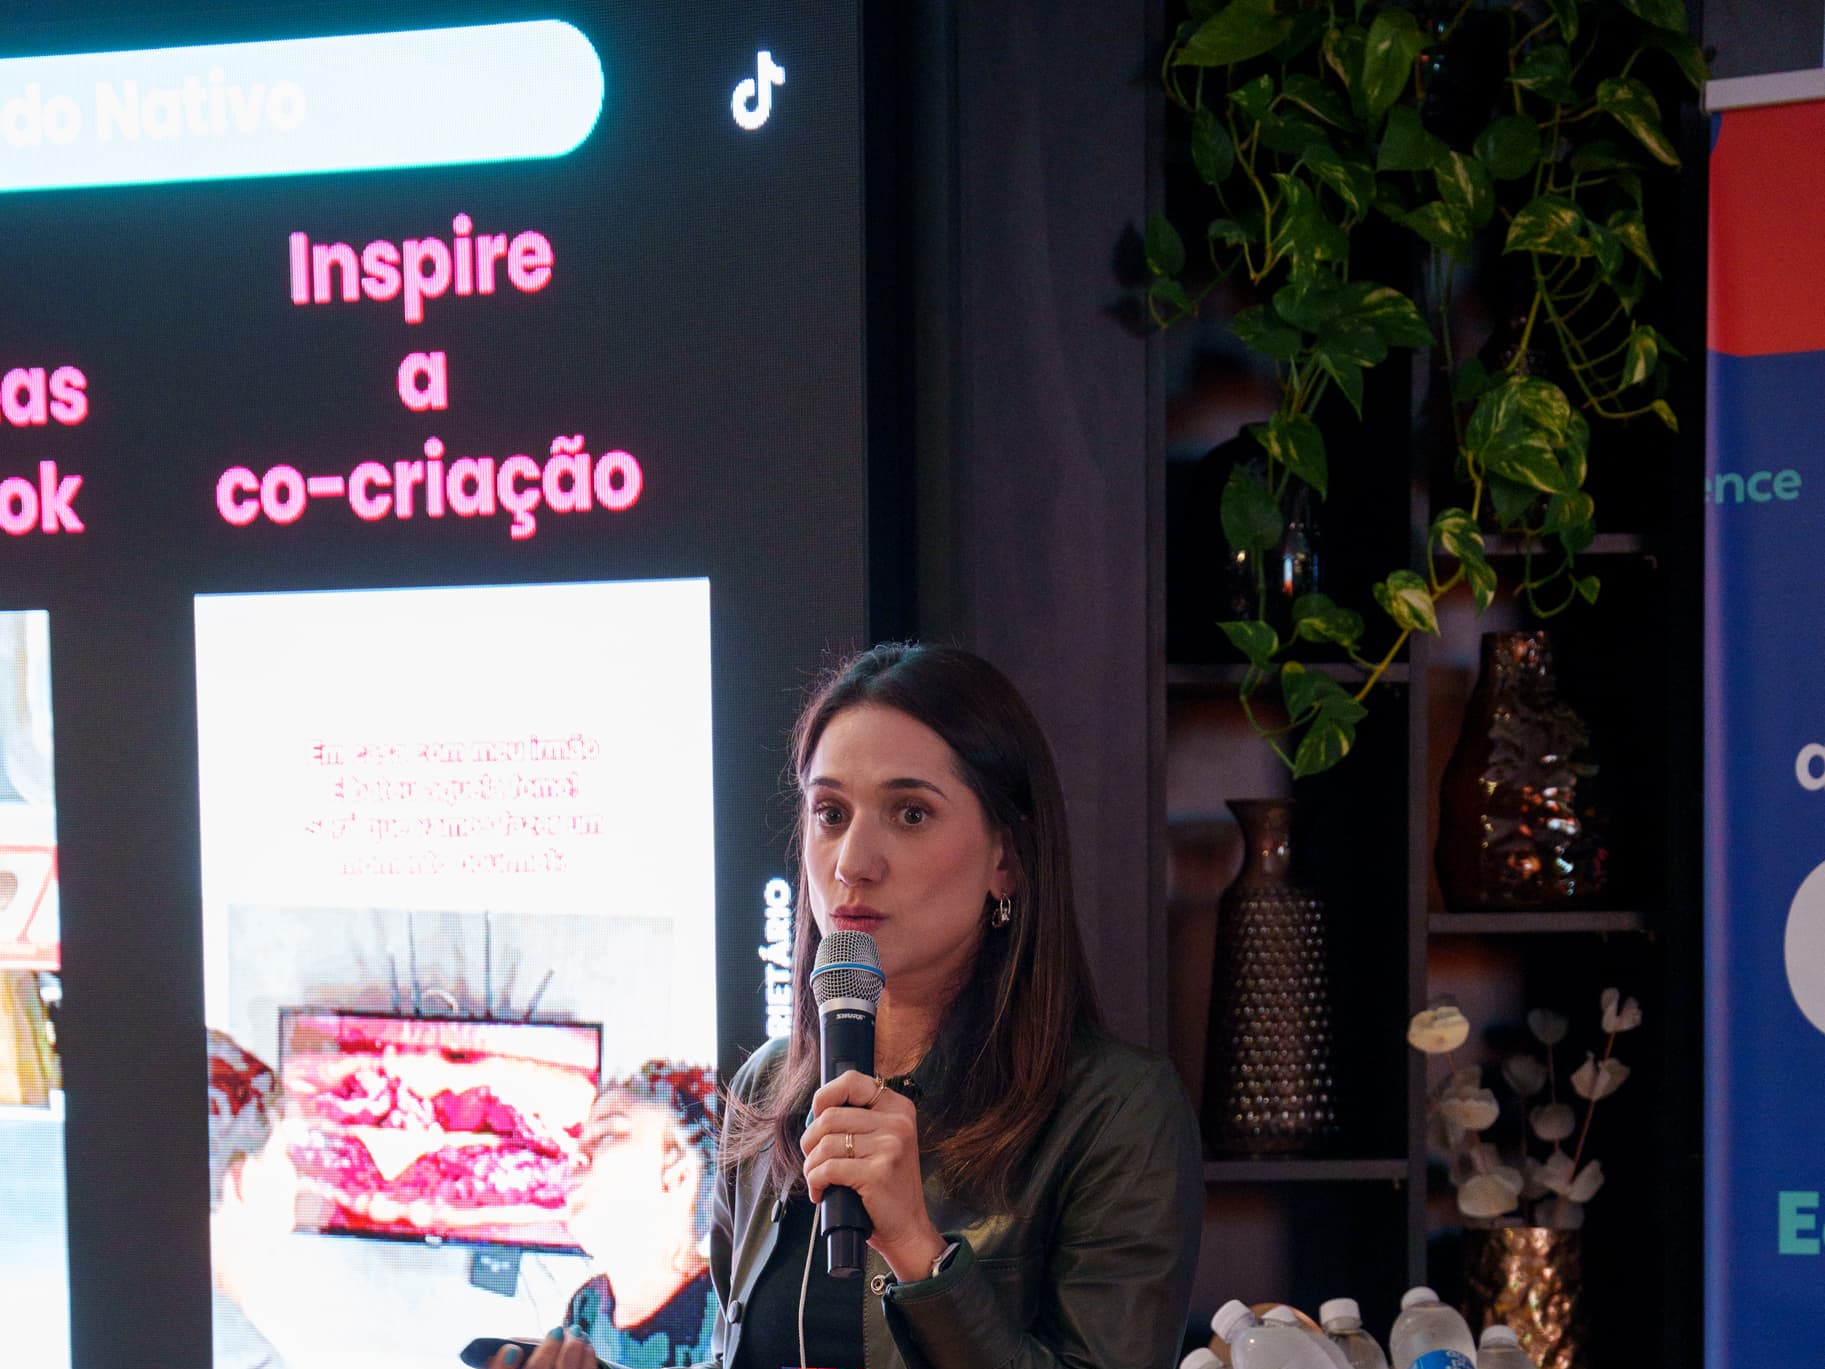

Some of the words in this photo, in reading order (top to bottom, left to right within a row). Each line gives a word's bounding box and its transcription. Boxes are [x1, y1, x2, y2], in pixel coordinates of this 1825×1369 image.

[96, 67, 307, 143] Nativo
[289, 213, 555, 324] Inspire
[0, 366, 88, 427] as
[397, 351, 448, 412] a
[216, 434, 643, 540] co-criação
[1705, 469, 1802, 504] nce
